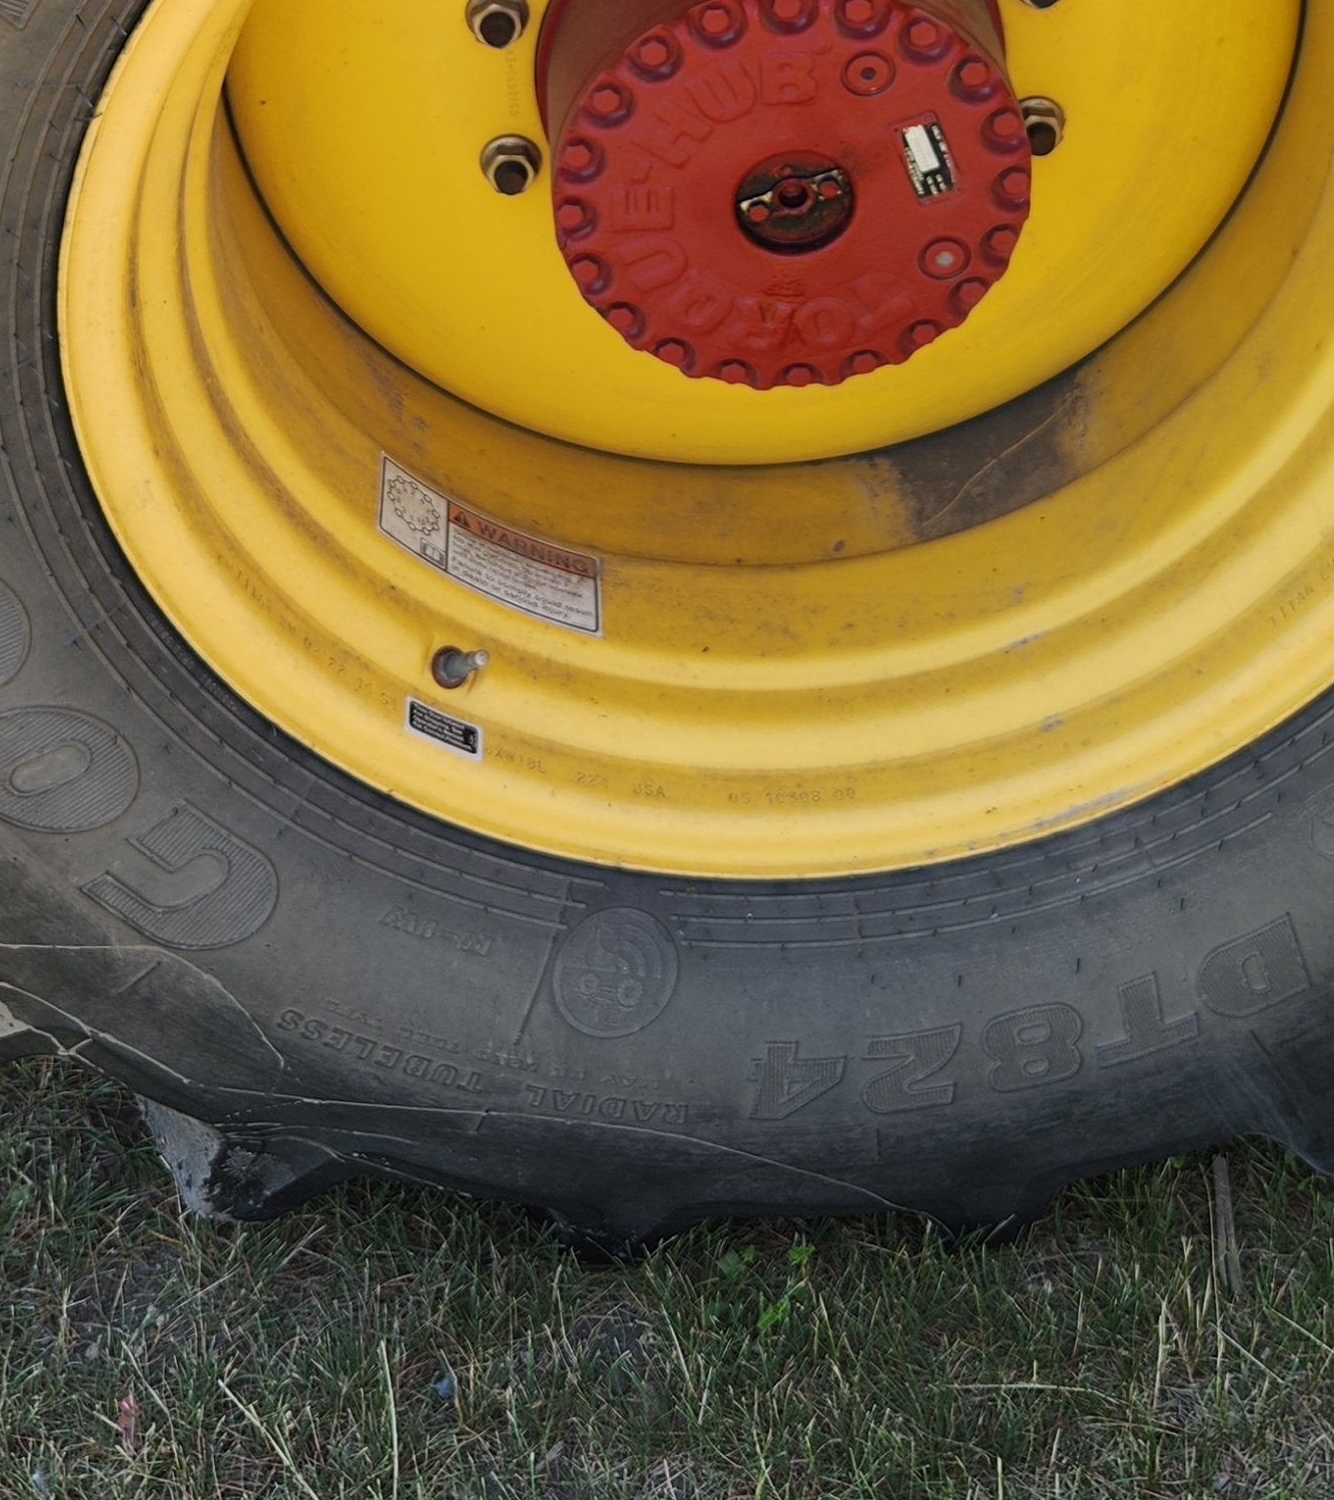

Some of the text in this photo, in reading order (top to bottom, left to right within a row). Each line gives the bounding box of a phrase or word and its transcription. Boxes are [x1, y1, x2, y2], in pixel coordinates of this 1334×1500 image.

[478, 520, 588, 573] WARNING
[1269, 585, 1315, 626] TITAN
[632, 783, 666, 798] USA
[747, 913, 1312, 1122] DT824
[275, 1007, 689, 1124] RADIAL TUBELESS
